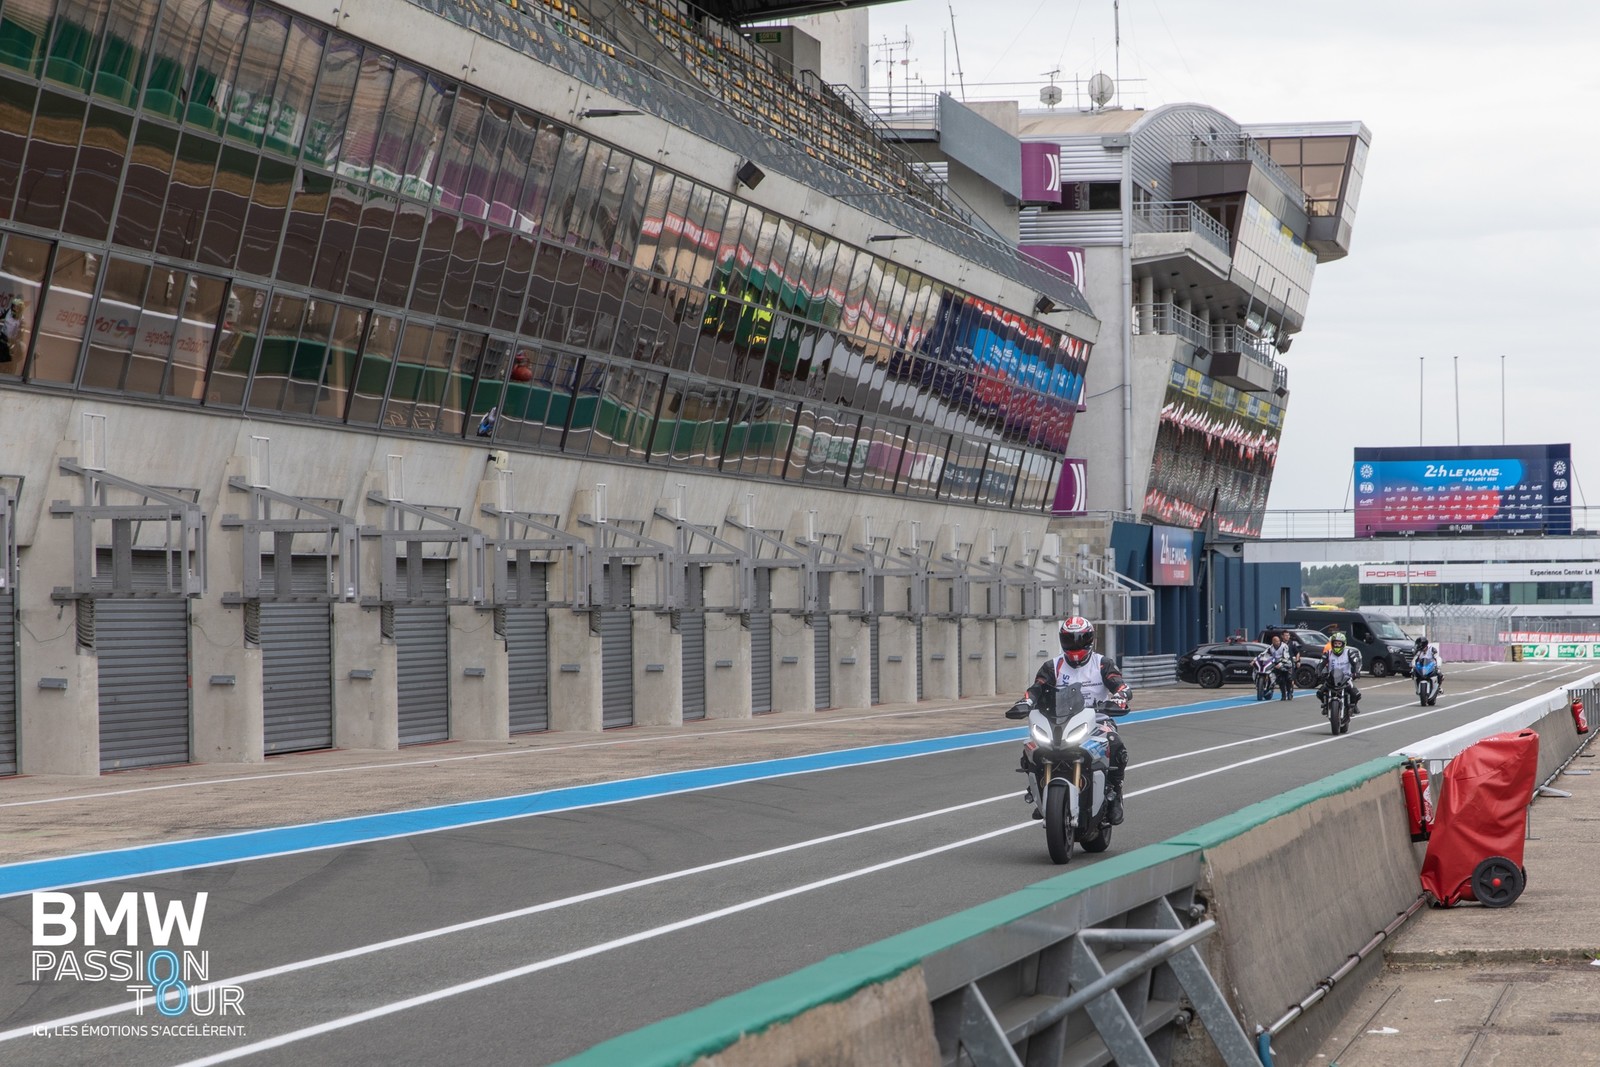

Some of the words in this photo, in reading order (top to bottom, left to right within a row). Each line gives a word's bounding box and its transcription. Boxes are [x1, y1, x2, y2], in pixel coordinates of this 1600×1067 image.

[1448, 469, 1464, 477] LE
[1465, 468, 1500, 477] MANS
[1360, 484, 1373, 492] FIA
[1553, 481, 1566, 489] FIA
